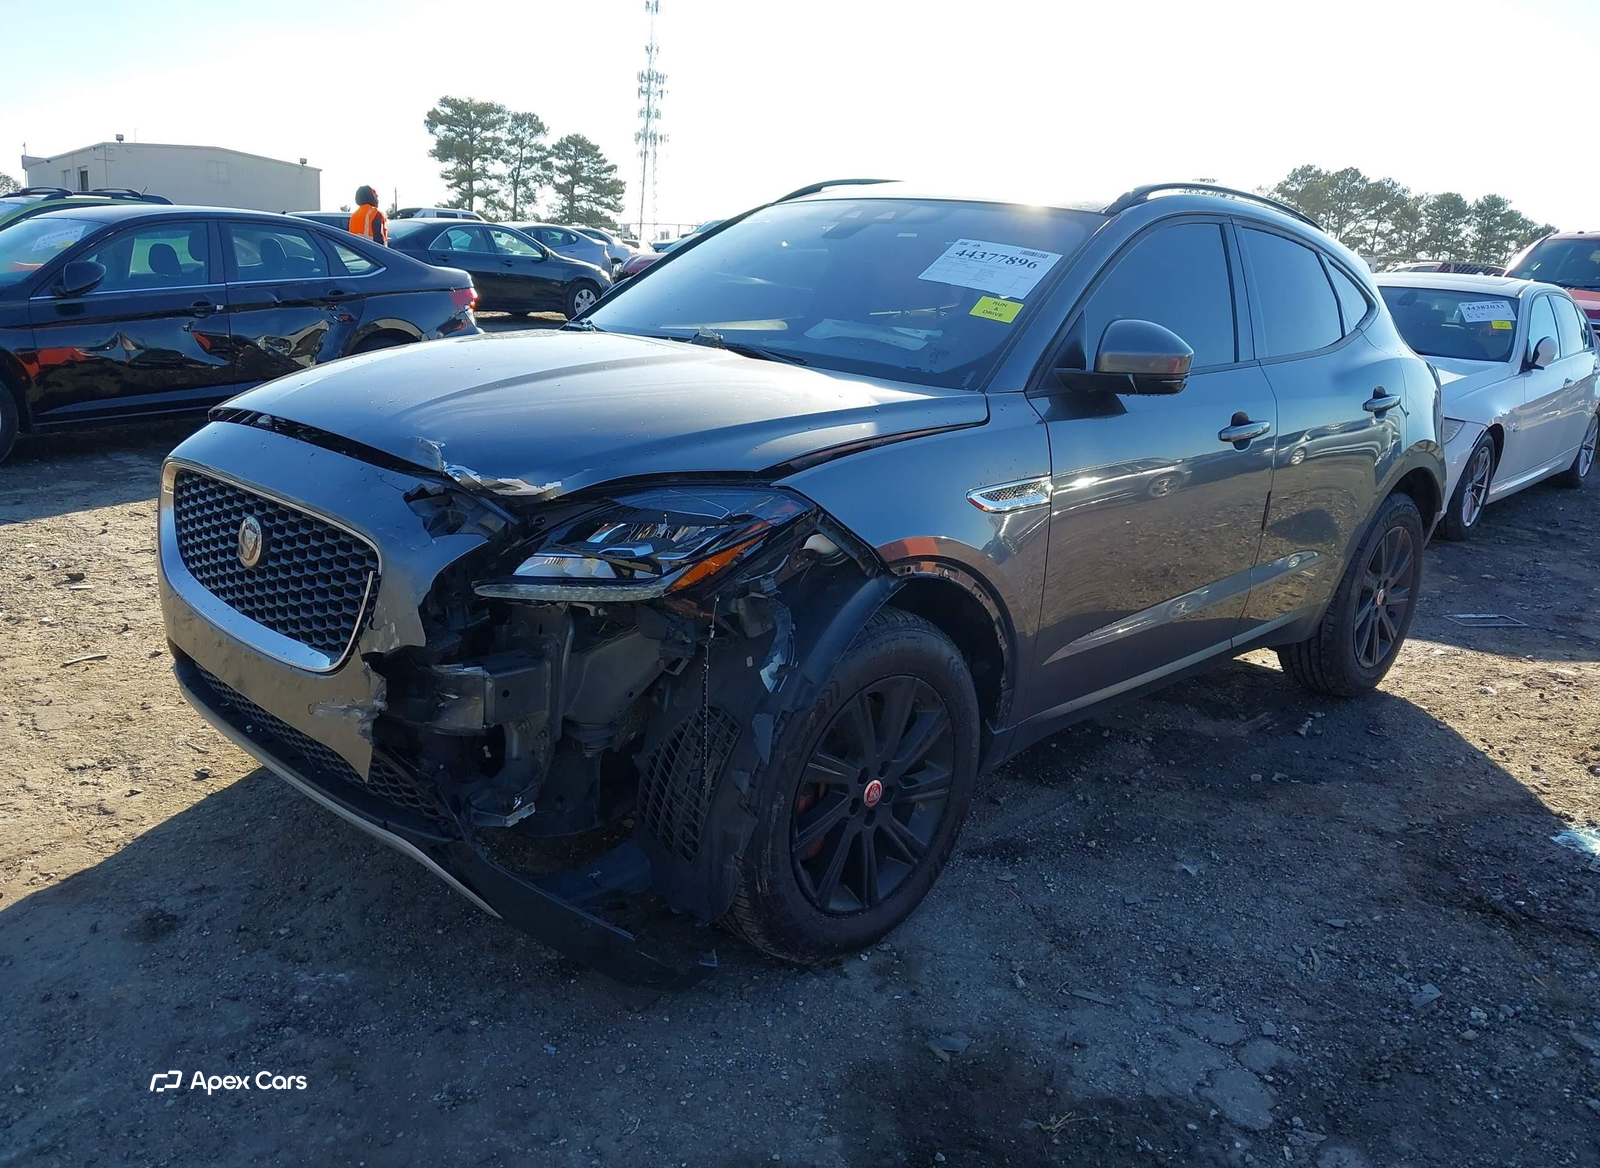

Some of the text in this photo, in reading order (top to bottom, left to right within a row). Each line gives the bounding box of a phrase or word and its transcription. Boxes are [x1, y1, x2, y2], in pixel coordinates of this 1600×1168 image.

[955, 249, 1038, 270] 44377896
[992, 300, 1008, 308] RUN
[982, 309, 1004, 318] DRIVE
